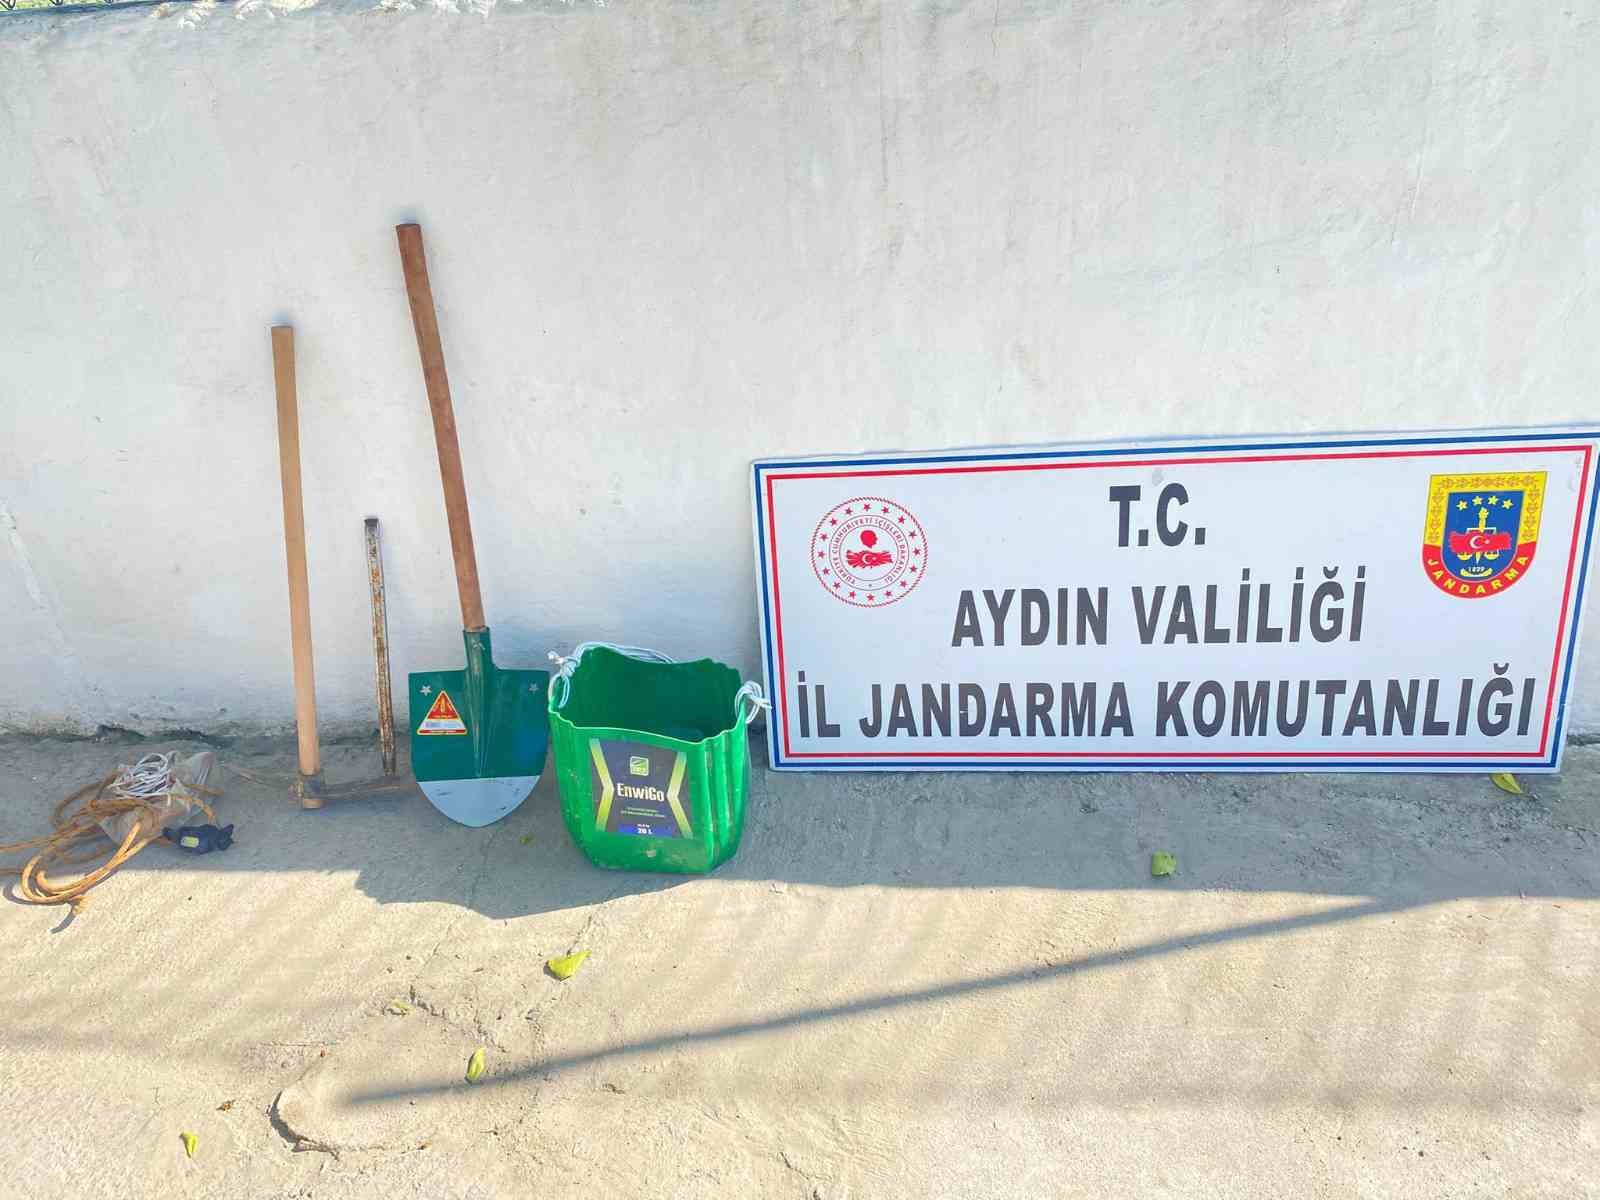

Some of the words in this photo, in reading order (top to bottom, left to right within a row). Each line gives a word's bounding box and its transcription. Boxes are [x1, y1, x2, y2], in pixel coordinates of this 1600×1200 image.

[1109, 483, 1206, 547] T.C.
[951, 588, 1108, 647] AYDIN
[1131, 565, 1366, 645] VALİLİĞİ
[1427, 556, 1529, 594] JANDARMA
[797, 670, 841, 738] İL
[859, 682, 1134, 738] JANDARMA
[1155, 662, 1536, 738] KOMUTANLIĞI
[616, 782, 665, 802] EnwiGo
